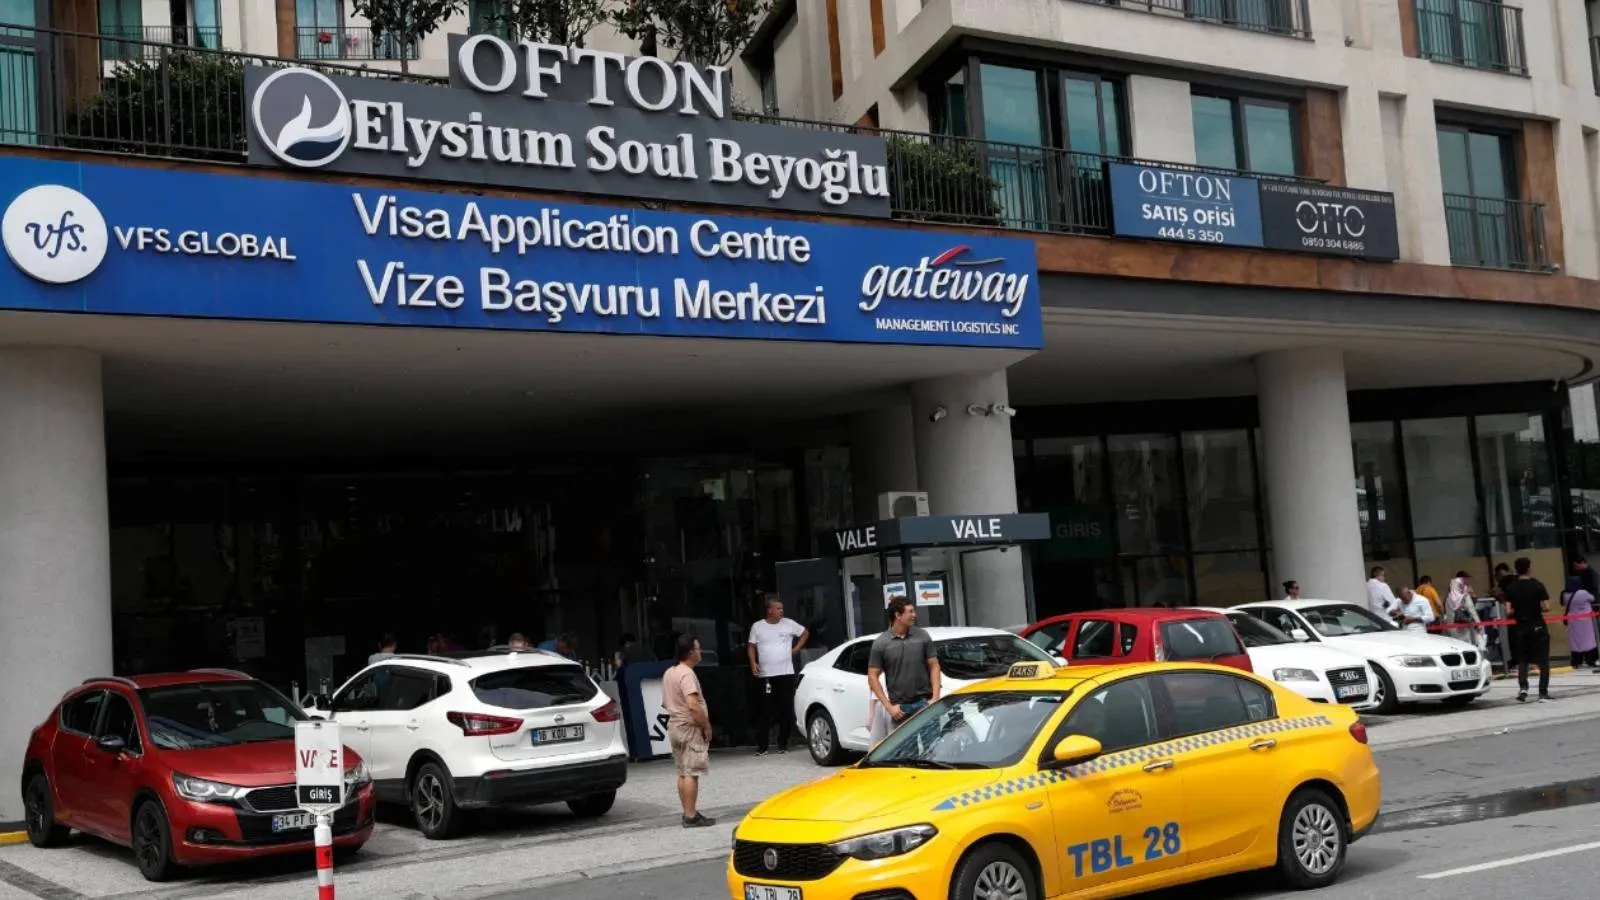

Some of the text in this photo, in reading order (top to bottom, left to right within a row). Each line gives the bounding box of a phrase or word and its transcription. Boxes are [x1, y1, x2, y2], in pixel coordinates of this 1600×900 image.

[458, 34, 730, 118] OFTON
[350, 99, 890, 204] Elysium Soul Beyoğlu
[1139, 169, 1231, 201] OFTON
[352, 193, 811, 263] Visa Application Centre
[1142, 203, 1235, 227] SATIŞ OFİSİ
[1295, 200, 1366, 237] OTTO
[25, 210, 88, 258] vfs.
[114, 226, 297, 261] VFS.GLOBAL
[1158, 226, 1224, 243] 444 5 350
[1325, 238, 1341, 249] 304
[357, 259, 827, 325] Vize Başvuru Merkezi
[858, 256, 1029, 317] gateway
[876, 317, 1020, 335] MANAGEMENT LOGISTICS INC
[835, 526, 877, 552] VALE
[950, 518, 1003, 539] VALE
[649, 704, 672, 742] VA
[309, 788, 333, 803] GİRİŞ
[1066, 821, 1182, 878] TBL 28
